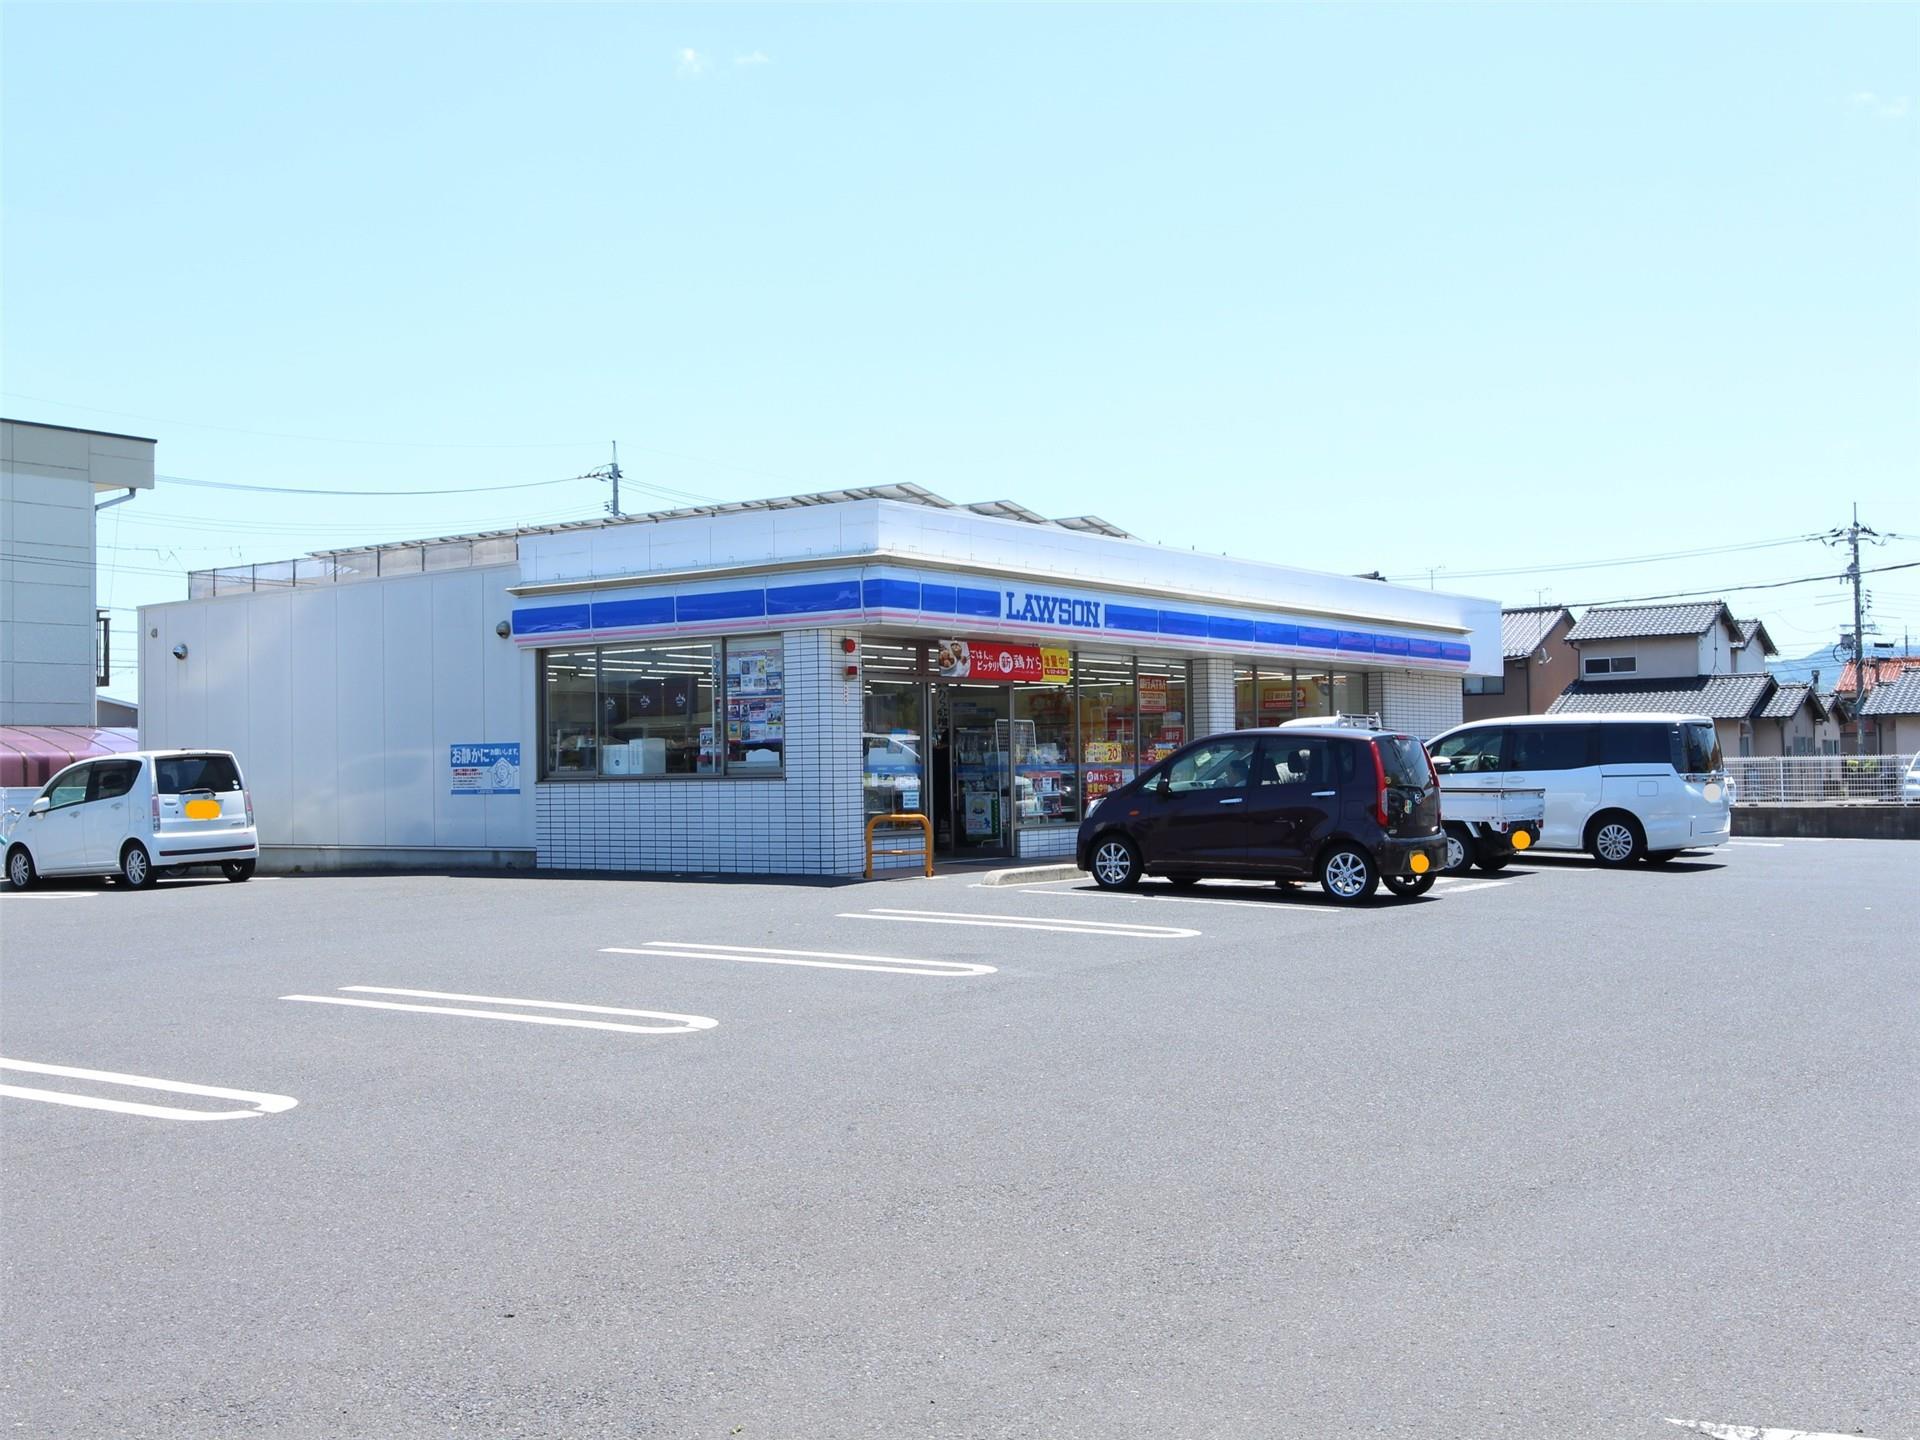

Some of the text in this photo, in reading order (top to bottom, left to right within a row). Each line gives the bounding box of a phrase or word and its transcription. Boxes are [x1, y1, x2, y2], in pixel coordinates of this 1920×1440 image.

[1006, 592, 1100, 628] LAWSON
[970, 650, 993, 660] ごはんに
[452, 748, 490, 764] お静かに
